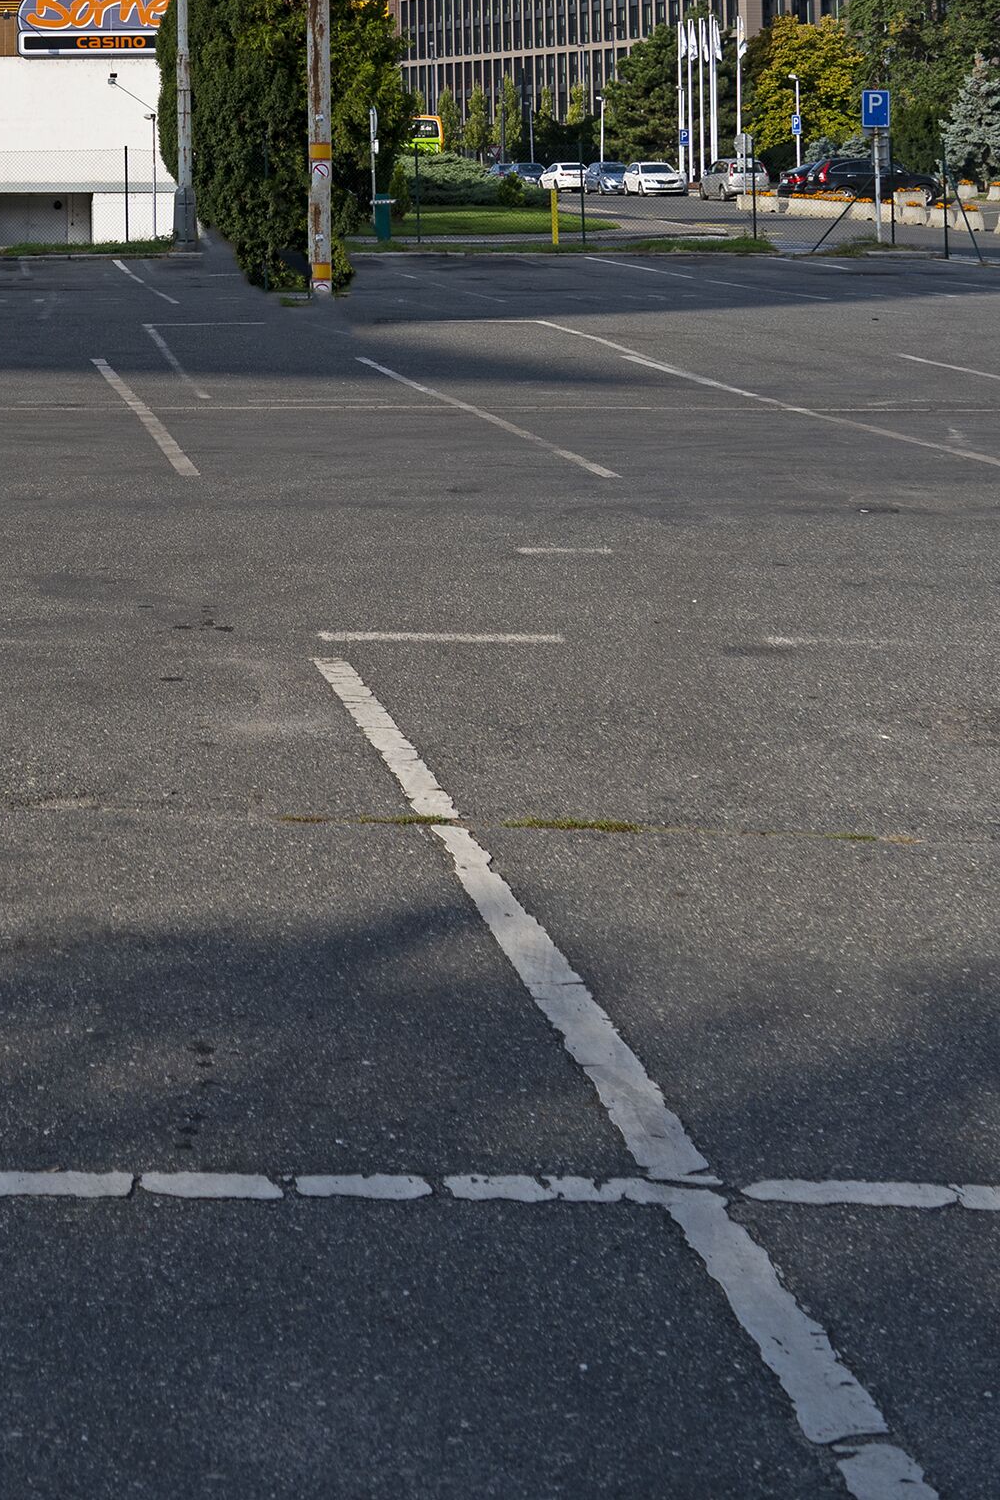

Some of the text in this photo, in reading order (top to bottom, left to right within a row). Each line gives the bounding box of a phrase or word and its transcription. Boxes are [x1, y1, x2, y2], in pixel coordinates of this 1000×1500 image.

[77, 37, 146, 49] casino
[869, 94, 883, 113] P
[681, 131, 688, 141] P
